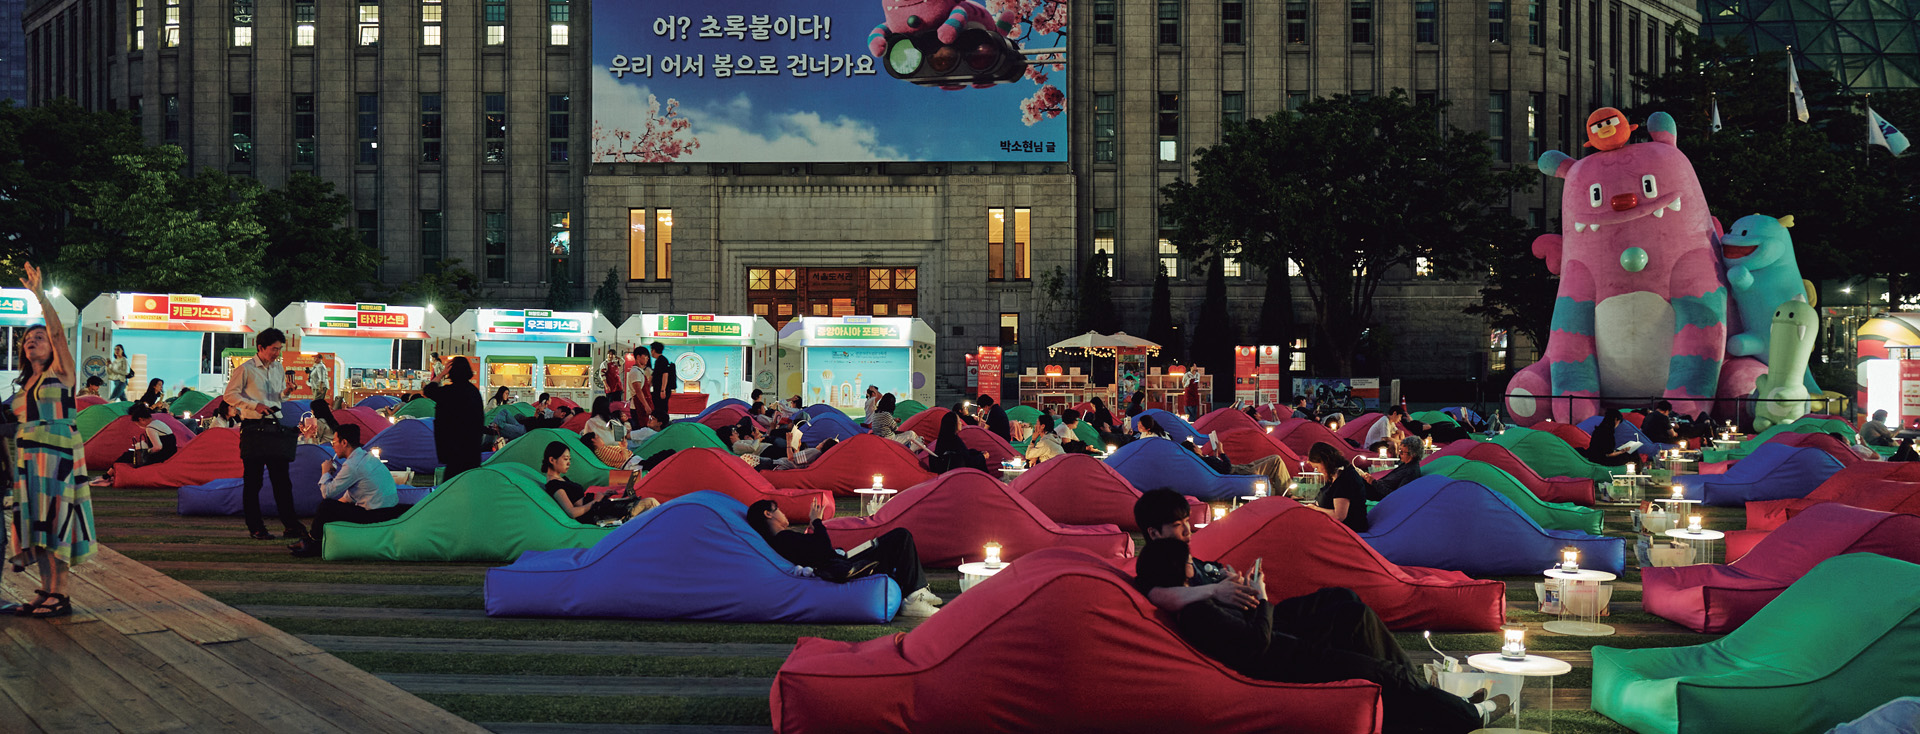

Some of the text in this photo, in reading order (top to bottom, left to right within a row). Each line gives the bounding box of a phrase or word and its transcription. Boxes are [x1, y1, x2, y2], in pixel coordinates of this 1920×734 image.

[653, 14, 831, 40] 어? 초록불이다!
[609, 53, 876, 78] 우리 어서 봄으로 건너가요
[1000, 140, 1056, 153] 박소현님 글
[0, 299, 24, 311] 스탄
[173, 306, 230, 319] 키르기스스탄
[360, 314, 405, 325] 타지키스탄
[817, 326, 897, 337] 중앙아시아 포토부스
